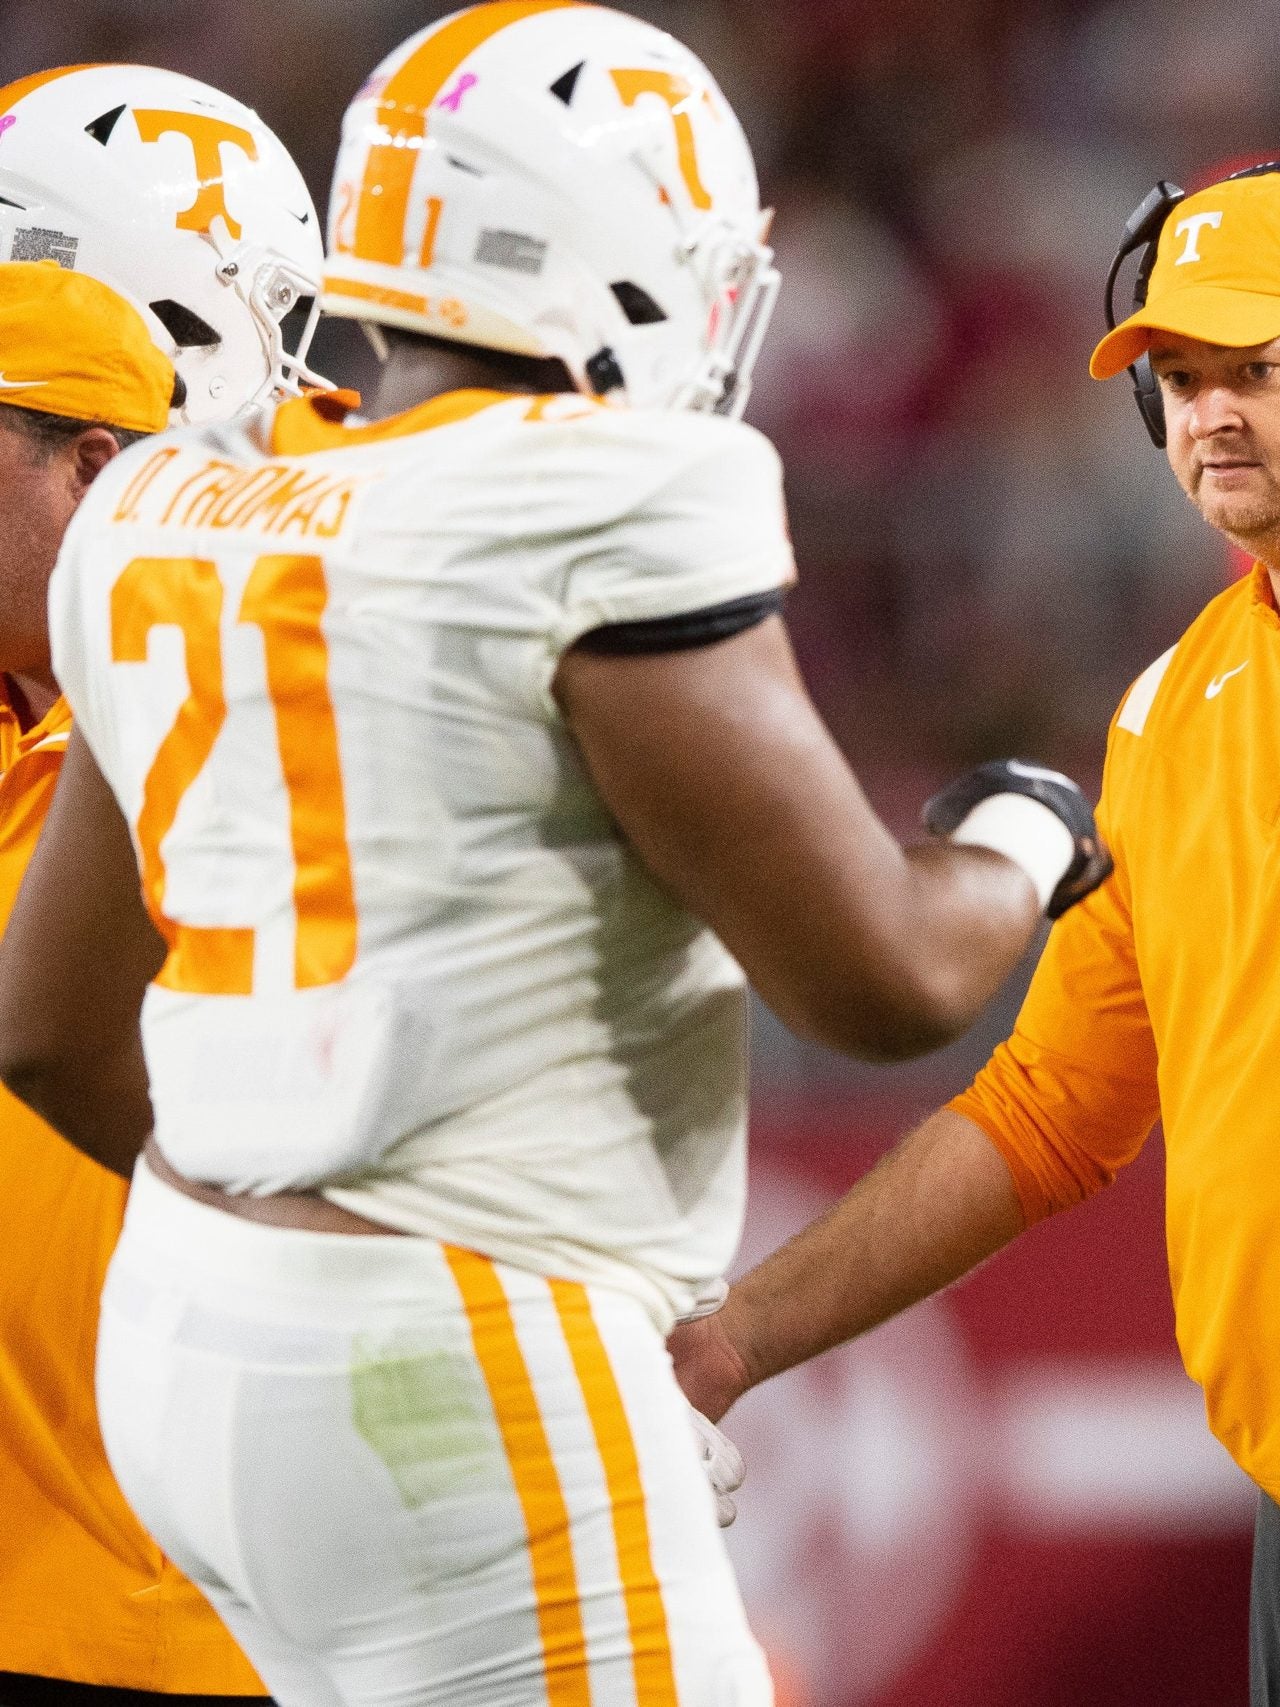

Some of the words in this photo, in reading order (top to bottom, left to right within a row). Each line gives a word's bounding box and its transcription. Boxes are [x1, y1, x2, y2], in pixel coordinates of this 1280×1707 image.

[132, 109, 259, 241] T
[1174, 211, 1223, 266] T
[161, 460, 355, 538] THOMAS
[111, 554, 360, 996] 21
